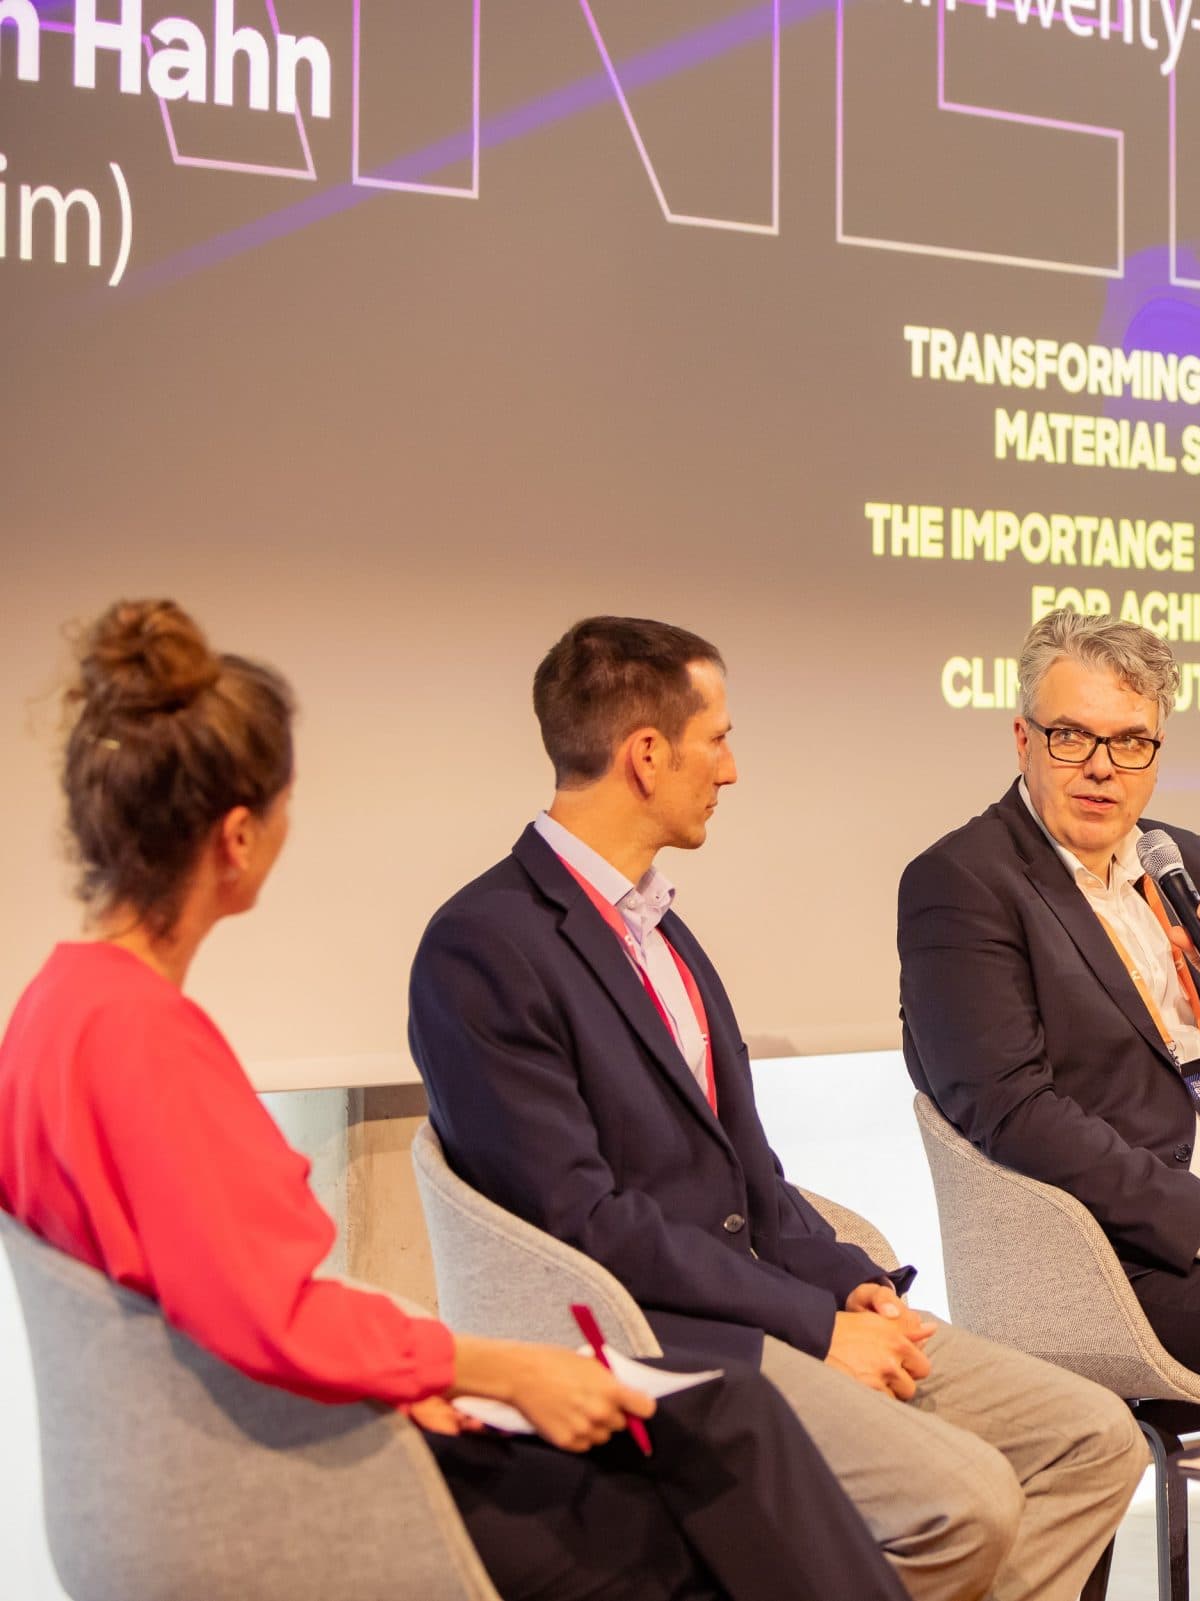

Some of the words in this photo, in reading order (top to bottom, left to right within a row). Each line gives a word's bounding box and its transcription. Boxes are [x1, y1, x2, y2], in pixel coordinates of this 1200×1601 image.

[73, 0, 331, 119] Hahn
[994, 407, 1177, 473] MATERIAL
[864, 502, 945, 559] THE
[951, 507, 1195, 572] IMPORTANCE
